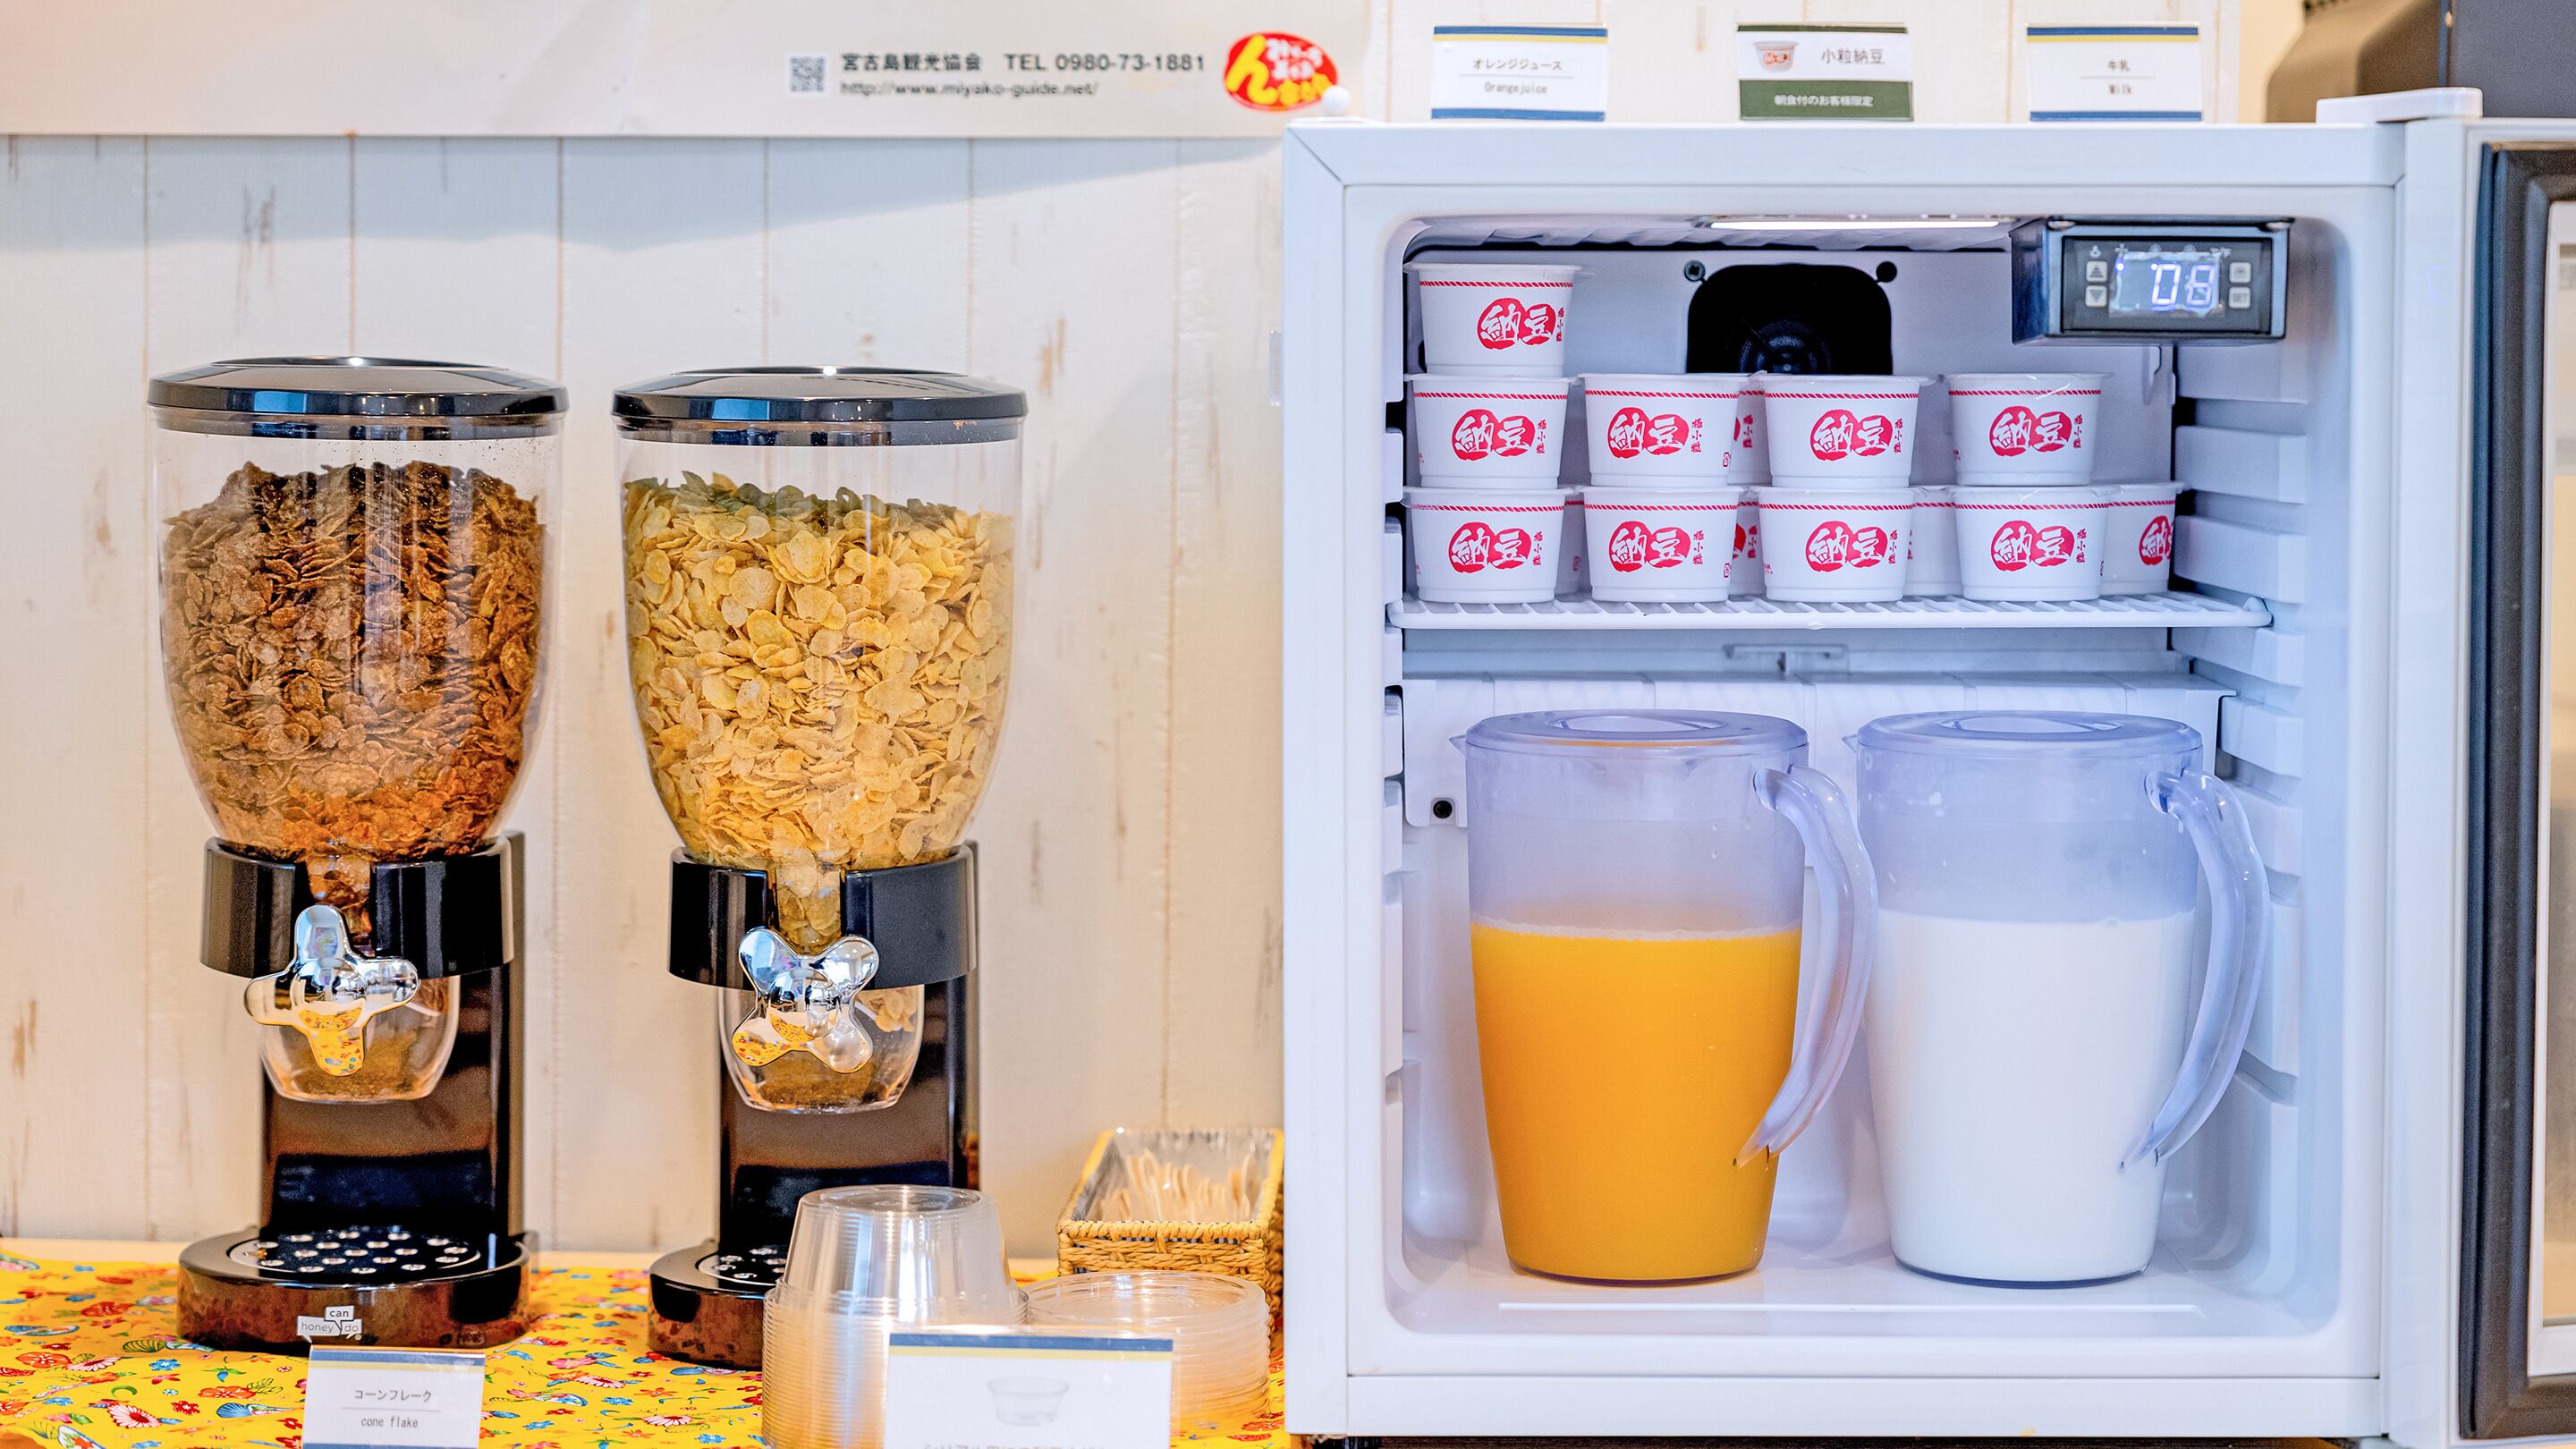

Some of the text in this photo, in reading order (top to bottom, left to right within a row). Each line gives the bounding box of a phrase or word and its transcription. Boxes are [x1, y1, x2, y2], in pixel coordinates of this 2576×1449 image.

[842, 52, 1205, 72] 宮古島観光協会 TEL 0980-73-1881
[1473, 57, 1562, 71] オレンジジュース
[1821, 47, 1885, 64] 小粒納豆
[1479, 301, 1554, 344] 納豆
[1453, 412, 1533, 454] 納豆
[1609, 411, 1686, 453] 納豆
[1812, 413, 1889, 454] 納豆
[1991, 410, 2068, 452] 納豆
[1450, 526, 1529, 570] 納豆
[1611, 525, 1687, 566] 納豆
[1808, 525, 1885, 568] 納豆
[1993, 524, 2072, 566] 納豆
[301, 1321, 360, 1334] honey do
[329, 1309, 350, 1318] can
[354, 1389, 432, 1403] コーンフレーク
[360, 1415, 419, 1428] cone flake
